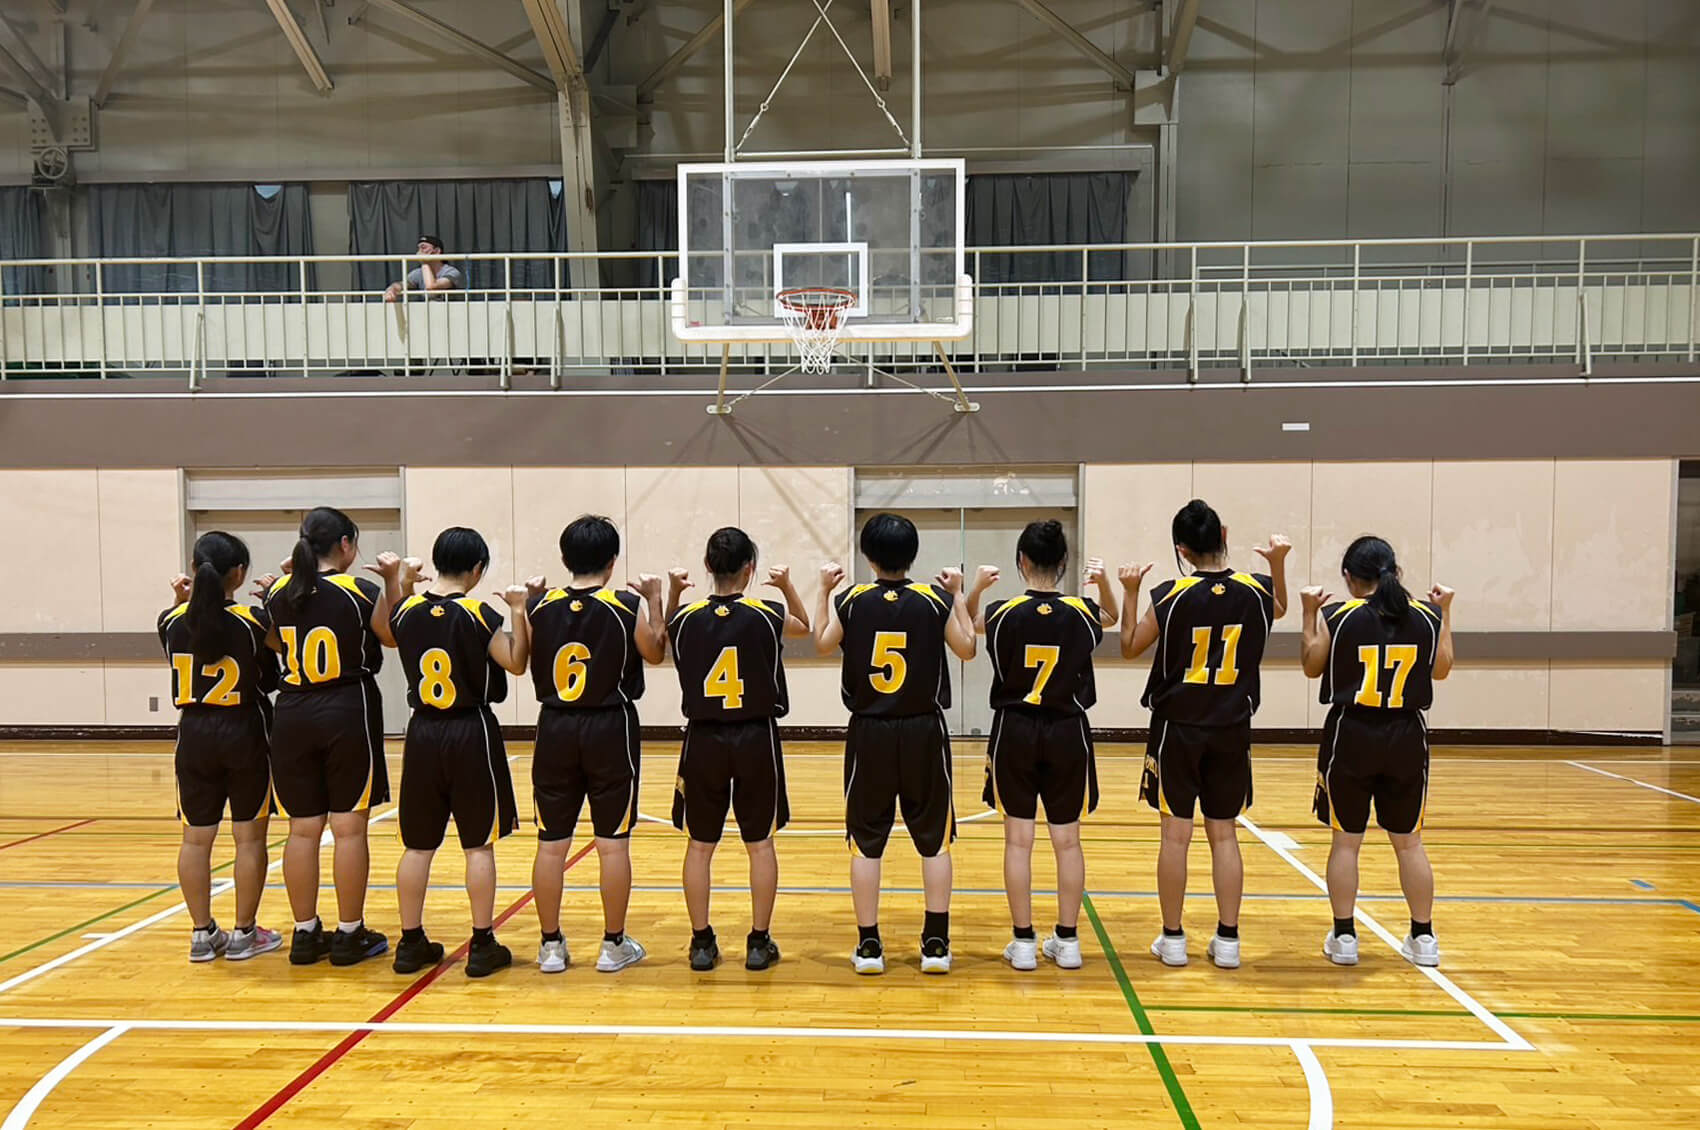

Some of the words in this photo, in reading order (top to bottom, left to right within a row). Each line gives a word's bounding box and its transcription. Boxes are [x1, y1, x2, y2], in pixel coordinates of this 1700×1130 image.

[171, 652, 241, 707] 12
[279, 625, 342, 687] 10
[418, 647, 458, 710] 8
[552, 641, 592, 703] 6
[703, 645, 745, 710] 4
[868, 631, 908, 695] 5
[1022, 644, 1060, 705] 7
[1182, 623, 1243, 686] 11
[1354, 644, 1418, 709] 17
